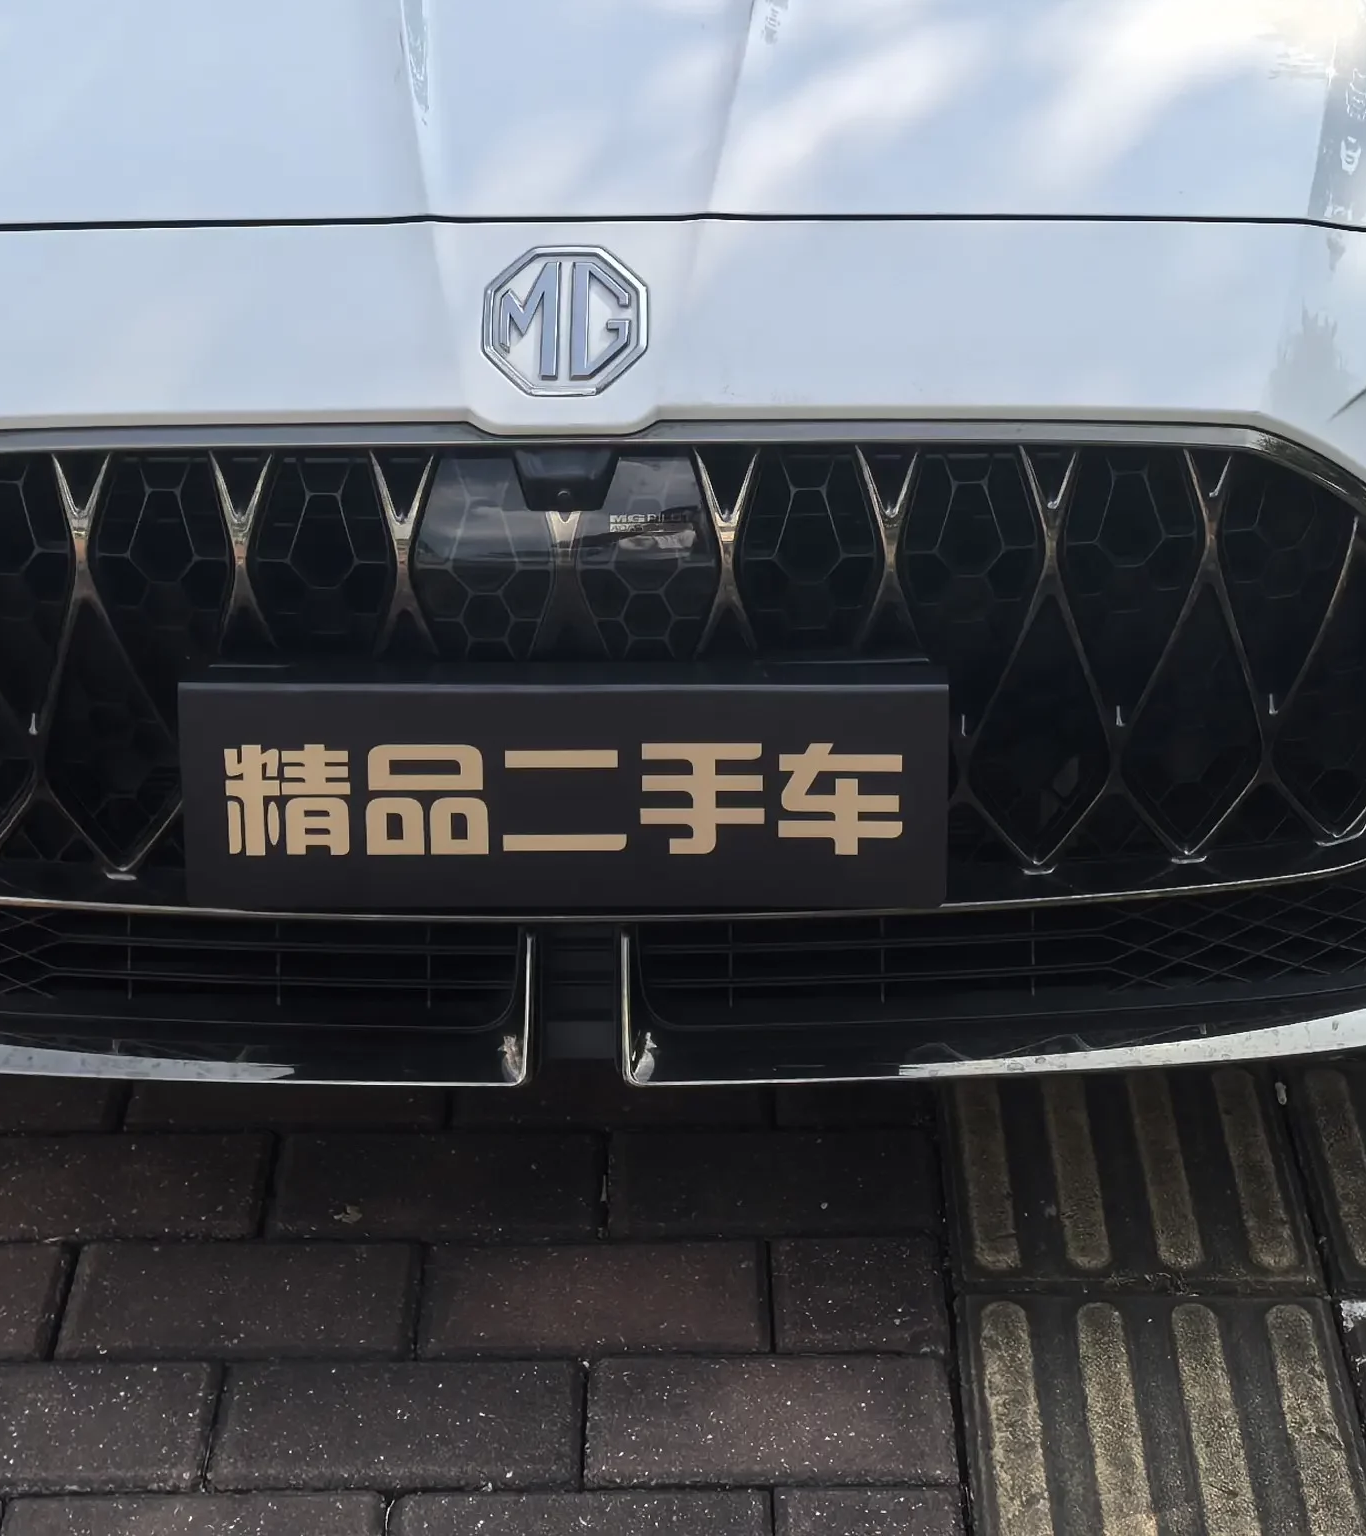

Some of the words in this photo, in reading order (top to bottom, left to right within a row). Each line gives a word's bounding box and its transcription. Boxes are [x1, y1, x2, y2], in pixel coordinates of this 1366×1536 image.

[499, 261, 632, 381] MG
[223, 742, 904, 856] 精品二手车
